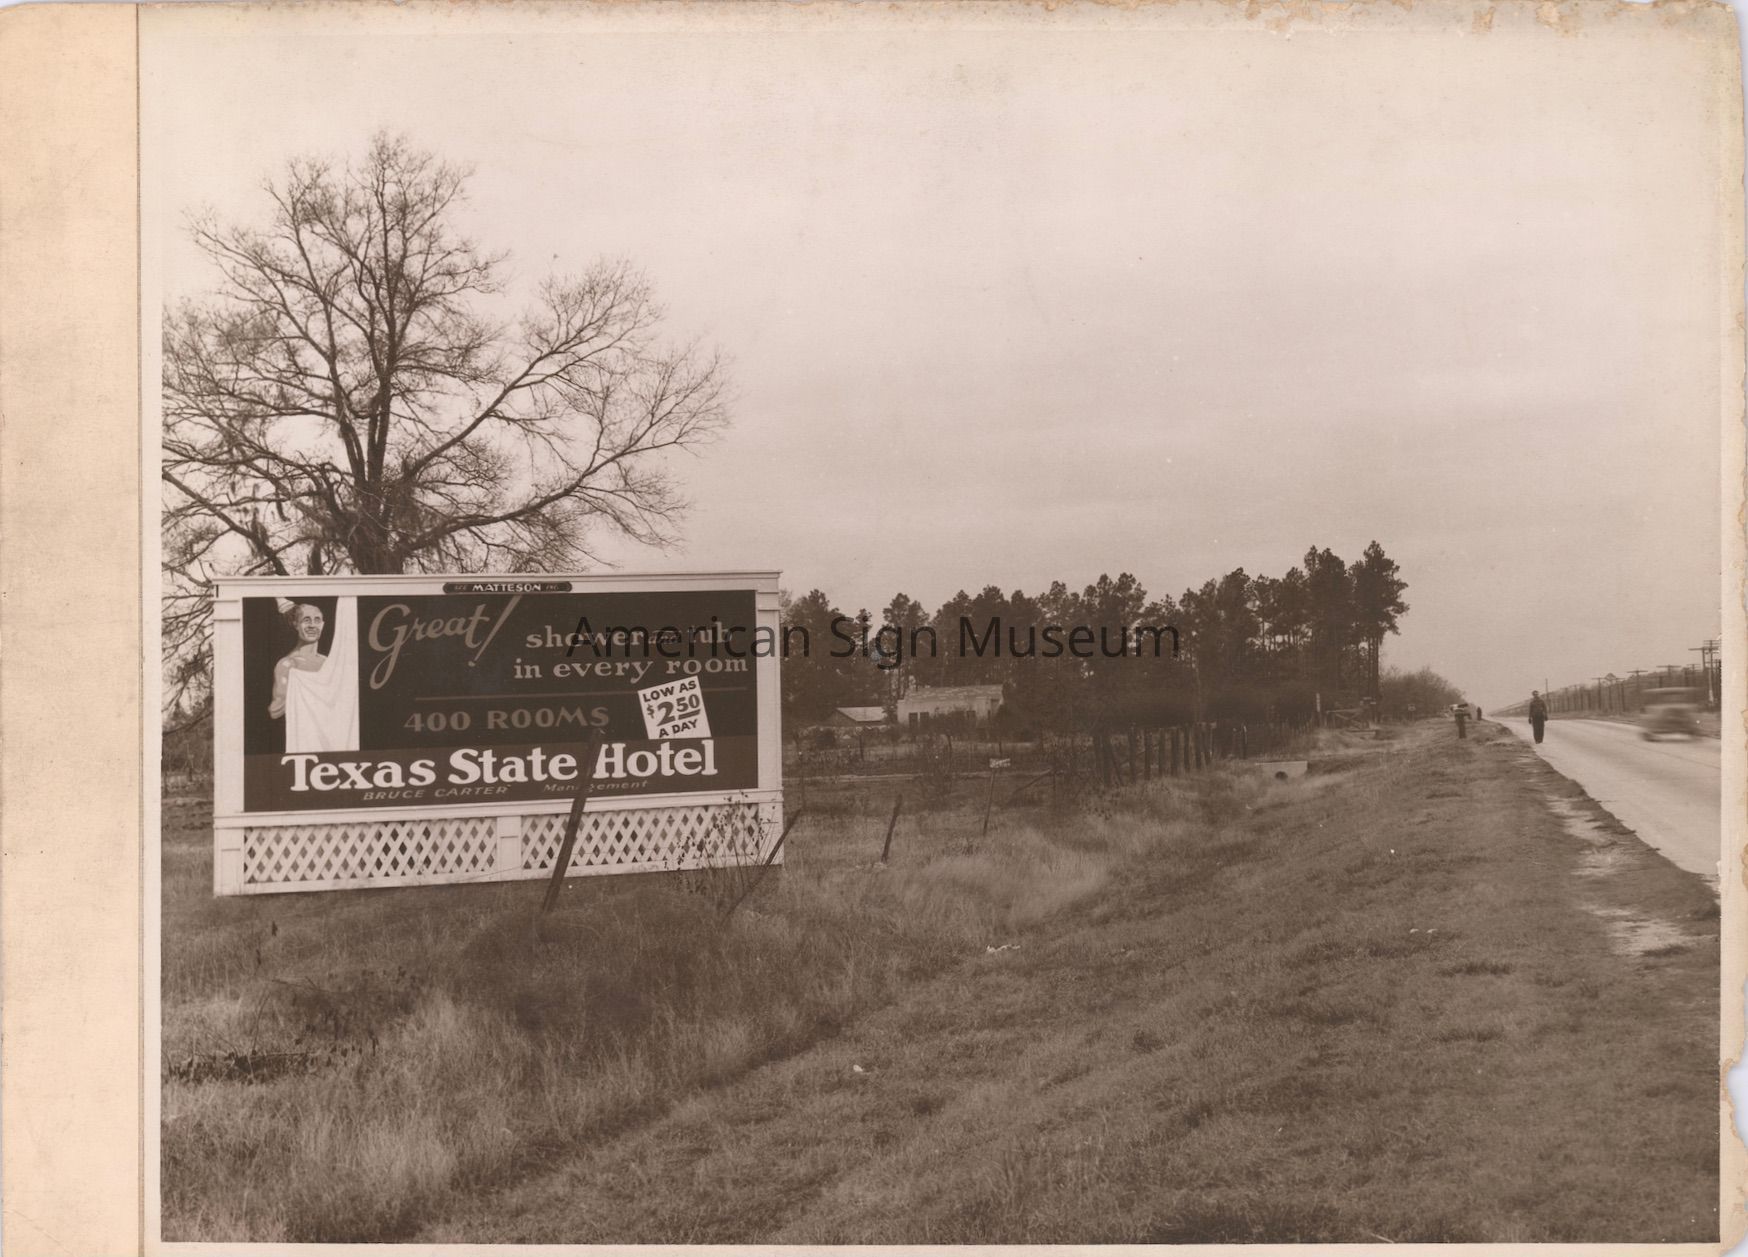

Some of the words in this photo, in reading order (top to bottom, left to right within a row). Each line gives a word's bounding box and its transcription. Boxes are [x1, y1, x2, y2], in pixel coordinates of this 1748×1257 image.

[472, 583, 541, 592] MATTESON
[525, 625, 644, 648] shower
[513, 658, 543, 679] in
[553, 661, 654, 684] every
[665, 658, 749, 675] room
[643, 686, 675, 703] LOW
[679, 680, 697, 693] AS
[403, 711, 472, 732] 400
[487, 707, 610, 730] ROOMS
[659, 728, 669, 738] A
[671, 718, 698, 734] DAY
[281, 754, 437, 792] Texas
[448, 747, 579, 785] State
[592, 739, 719, 779] Hotel
[363, 789, 425, 800] BRUCE
[434, 785, 510, 797] CARTER
[543, 780, 649, 793] Mangement
